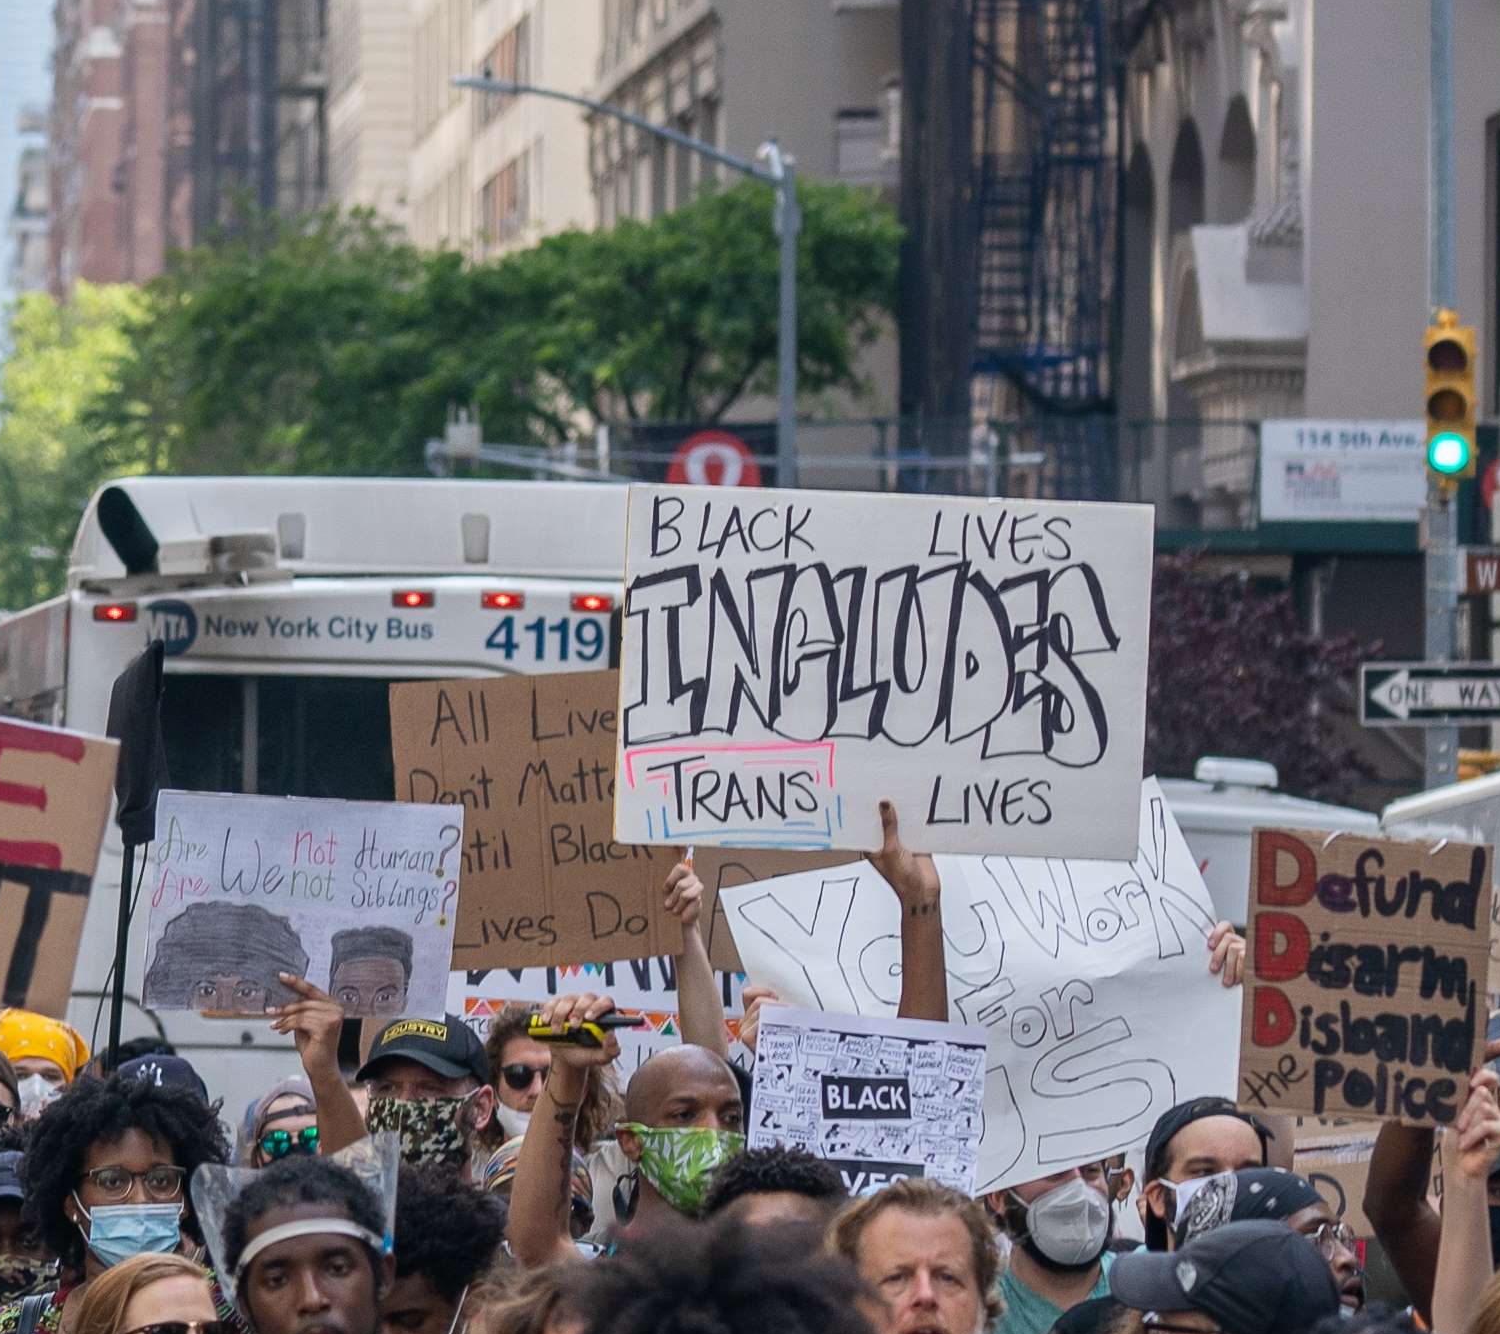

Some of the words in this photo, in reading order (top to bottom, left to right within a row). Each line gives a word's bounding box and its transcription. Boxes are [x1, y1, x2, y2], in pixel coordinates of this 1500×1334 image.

[652, 497, 816, 558] BLACK
[929, 509, 1072, 564] LIVES
[1477, 562, 1498, 587] W
[205, 614, 258, 637] New
[265, 614, 319, 638] York
[328, 616, 377, 643] City
[386, 618, 433, 640] Bus
[485, 616, 604, 661] 4119
[624, 560, 1121, 767] INCLUDES
[1388, 686, 1433, 704] ONE
[431, 689, 489, 746] All
[532, 689, 617, 741] Live
[518, 758, 614, 806] Matt
[647, 755, 819, 823] TRANS
[927, 778, 1051, 826] LIVES
[221, 827, 284, 895] We
[1256, 831, 1487, 931] Defund
[453, 907, 557, 950] ives
[587, 891, 648, 936] Do
[1254, 911, 1469, 1005] Disarm
[1252, 979, 1477, 1073] Disband
[826, 1084, 907, 1111] BLACK
[1244, 1053, 1308, 1109] the
[1314, 1058, 1458, 1125] Police
